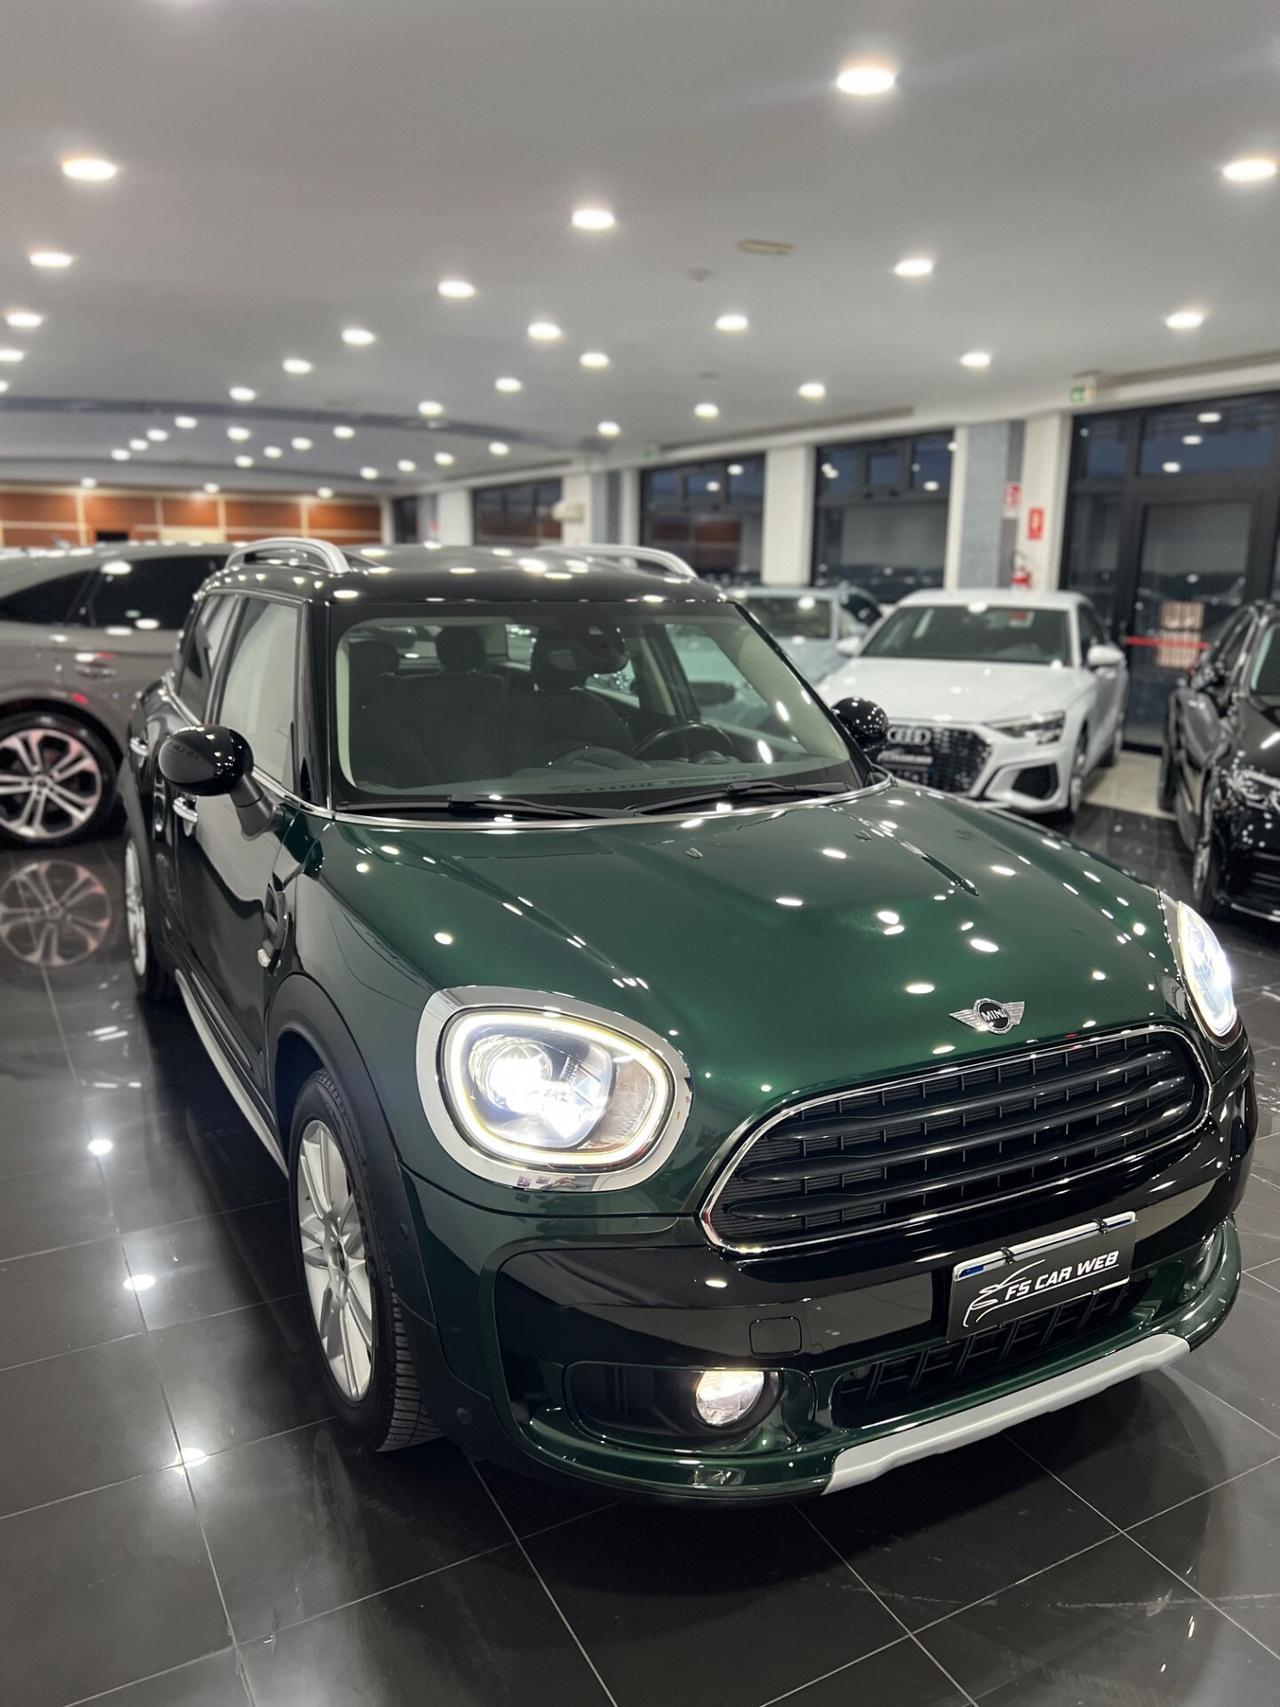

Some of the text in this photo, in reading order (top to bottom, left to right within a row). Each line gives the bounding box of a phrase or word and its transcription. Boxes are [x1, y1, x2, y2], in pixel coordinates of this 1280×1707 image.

[980, 1008, 1008, 1021] MINI
[1005, 1250, 1120, 1301] FS CAR WEB
